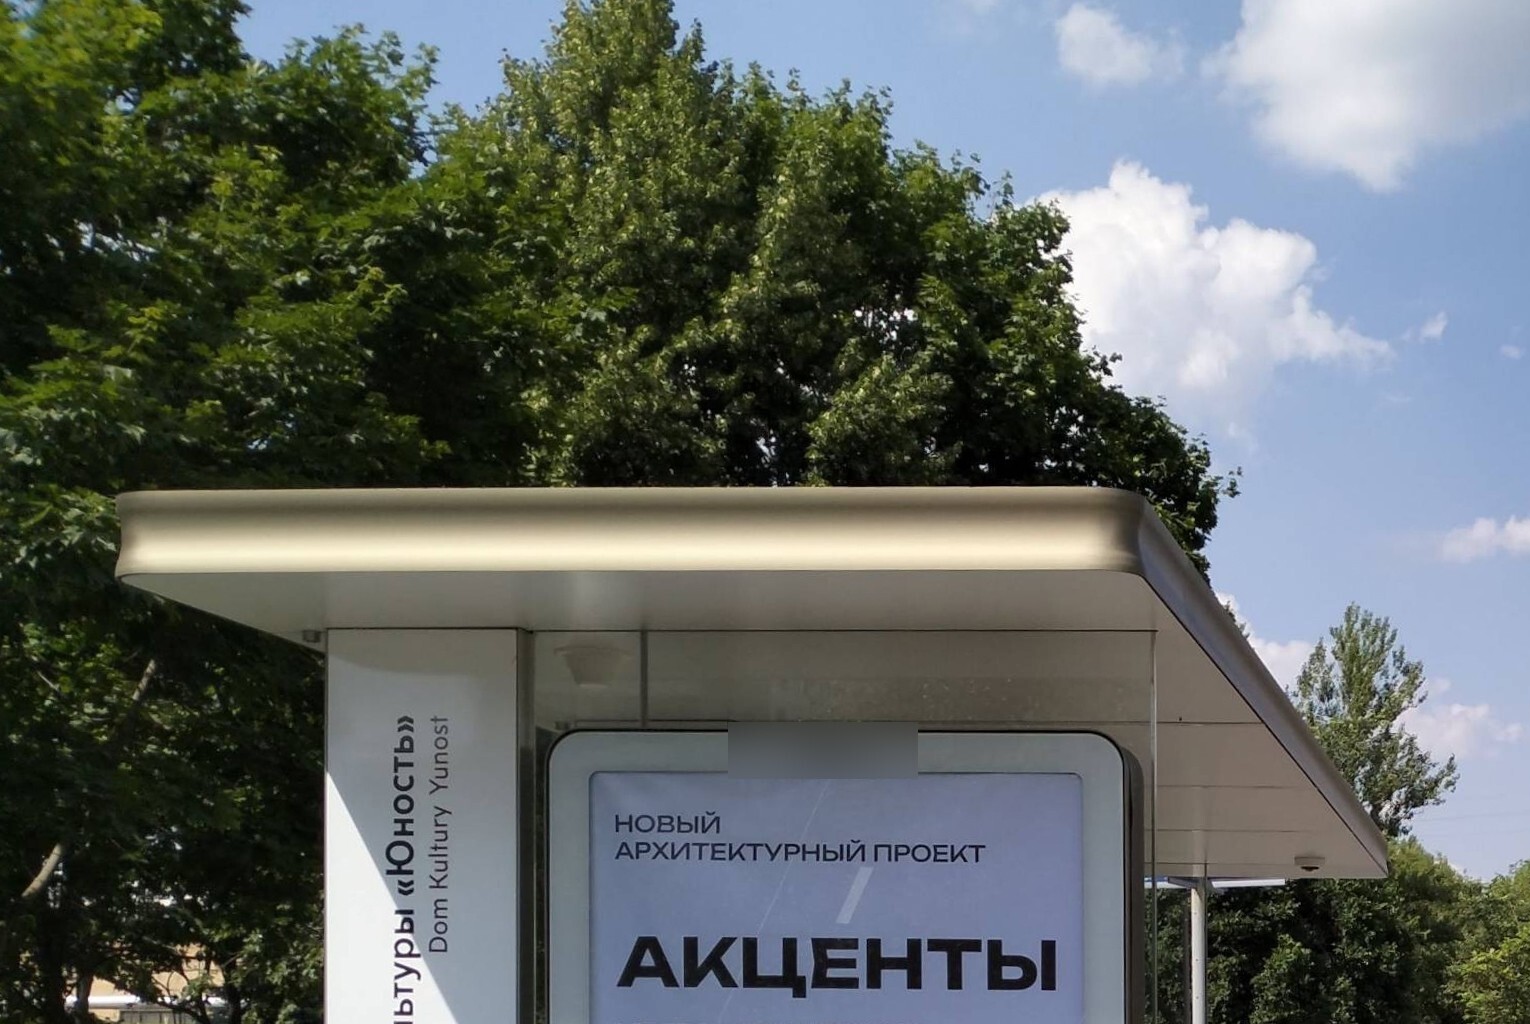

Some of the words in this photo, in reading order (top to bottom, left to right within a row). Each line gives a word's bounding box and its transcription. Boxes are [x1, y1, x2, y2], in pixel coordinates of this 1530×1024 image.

[428, 715, 449, 795] Yunost
[385, 715, 415, 896] «Юность»
[614, 811, 721, 834] НОВЫЙ
[428, 805, 453, 889] Kultury
[614, 840, 867, 863] АРХИТЕКТУРНЫЙ
[873, 844, 986, 863] ПРОЕКТ
[428, 898, 449, 953] Dom
[616, 935, 1057, 999] АКЦЕНТЫ
